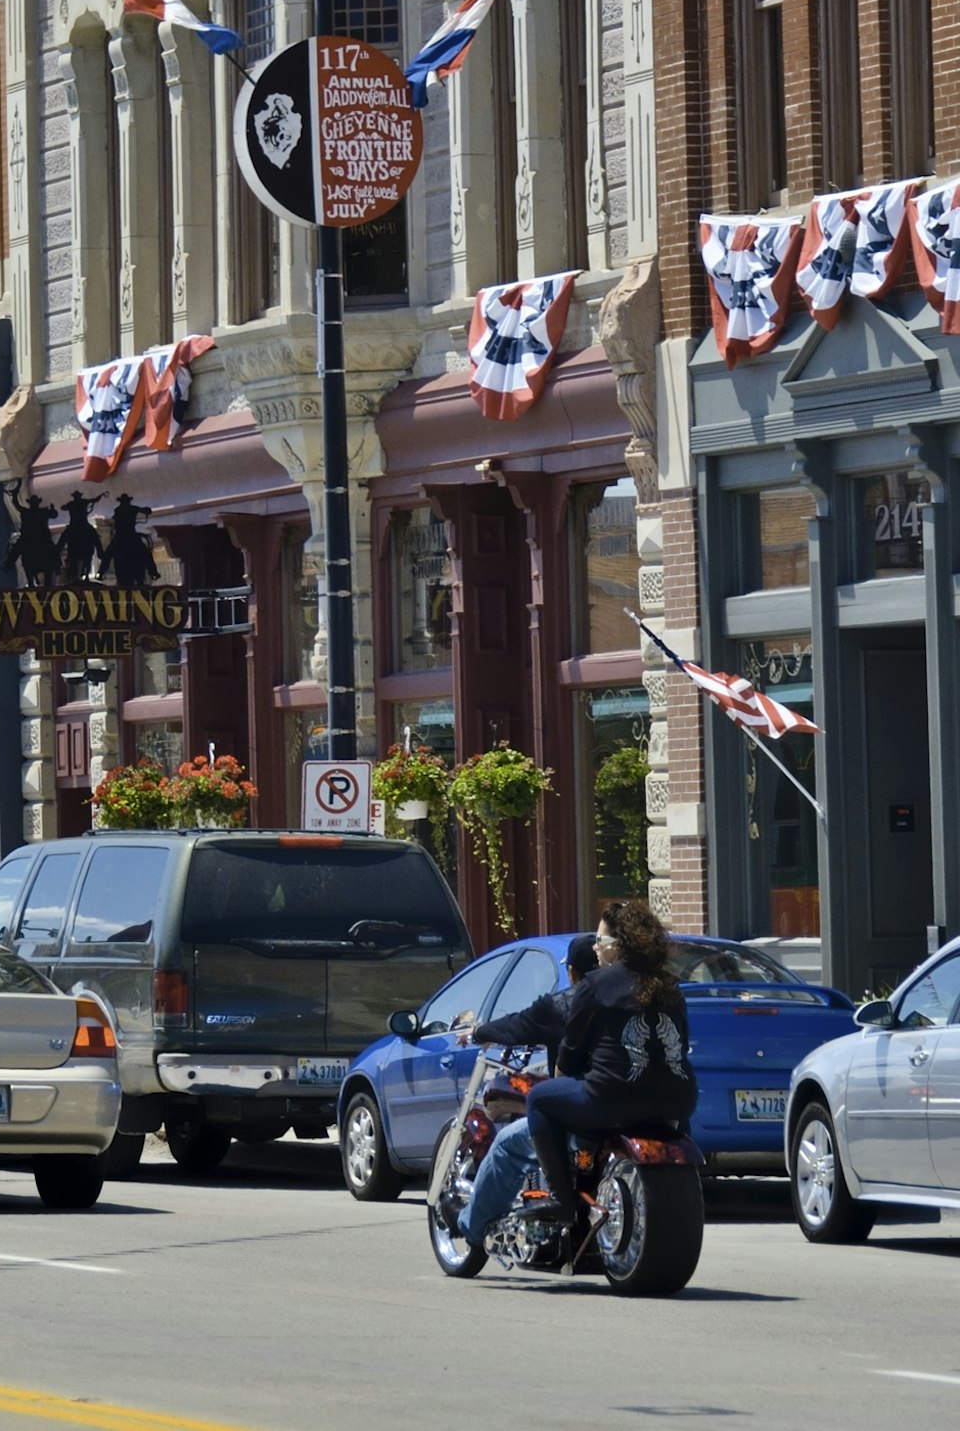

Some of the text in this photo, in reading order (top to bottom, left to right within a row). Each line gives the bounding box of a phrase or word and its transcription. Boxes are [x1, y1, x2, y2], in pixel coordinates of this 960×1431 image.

[320, 44, 370, 72] 117th
[328, 74, 394, 88] ANNUAL
[321, 113, 414, 141] CHEYENNE
[324, 140, 414, 161] FRONTIER
[346, 160, 390, 182] DAYS
[874, 500, 922, 541] 214
[42, 628, 133, 657] HOME
[311, 818, 362, 828] TOW AWAY ZONE
[206, 1015, 256, 1024] EXCURSION
